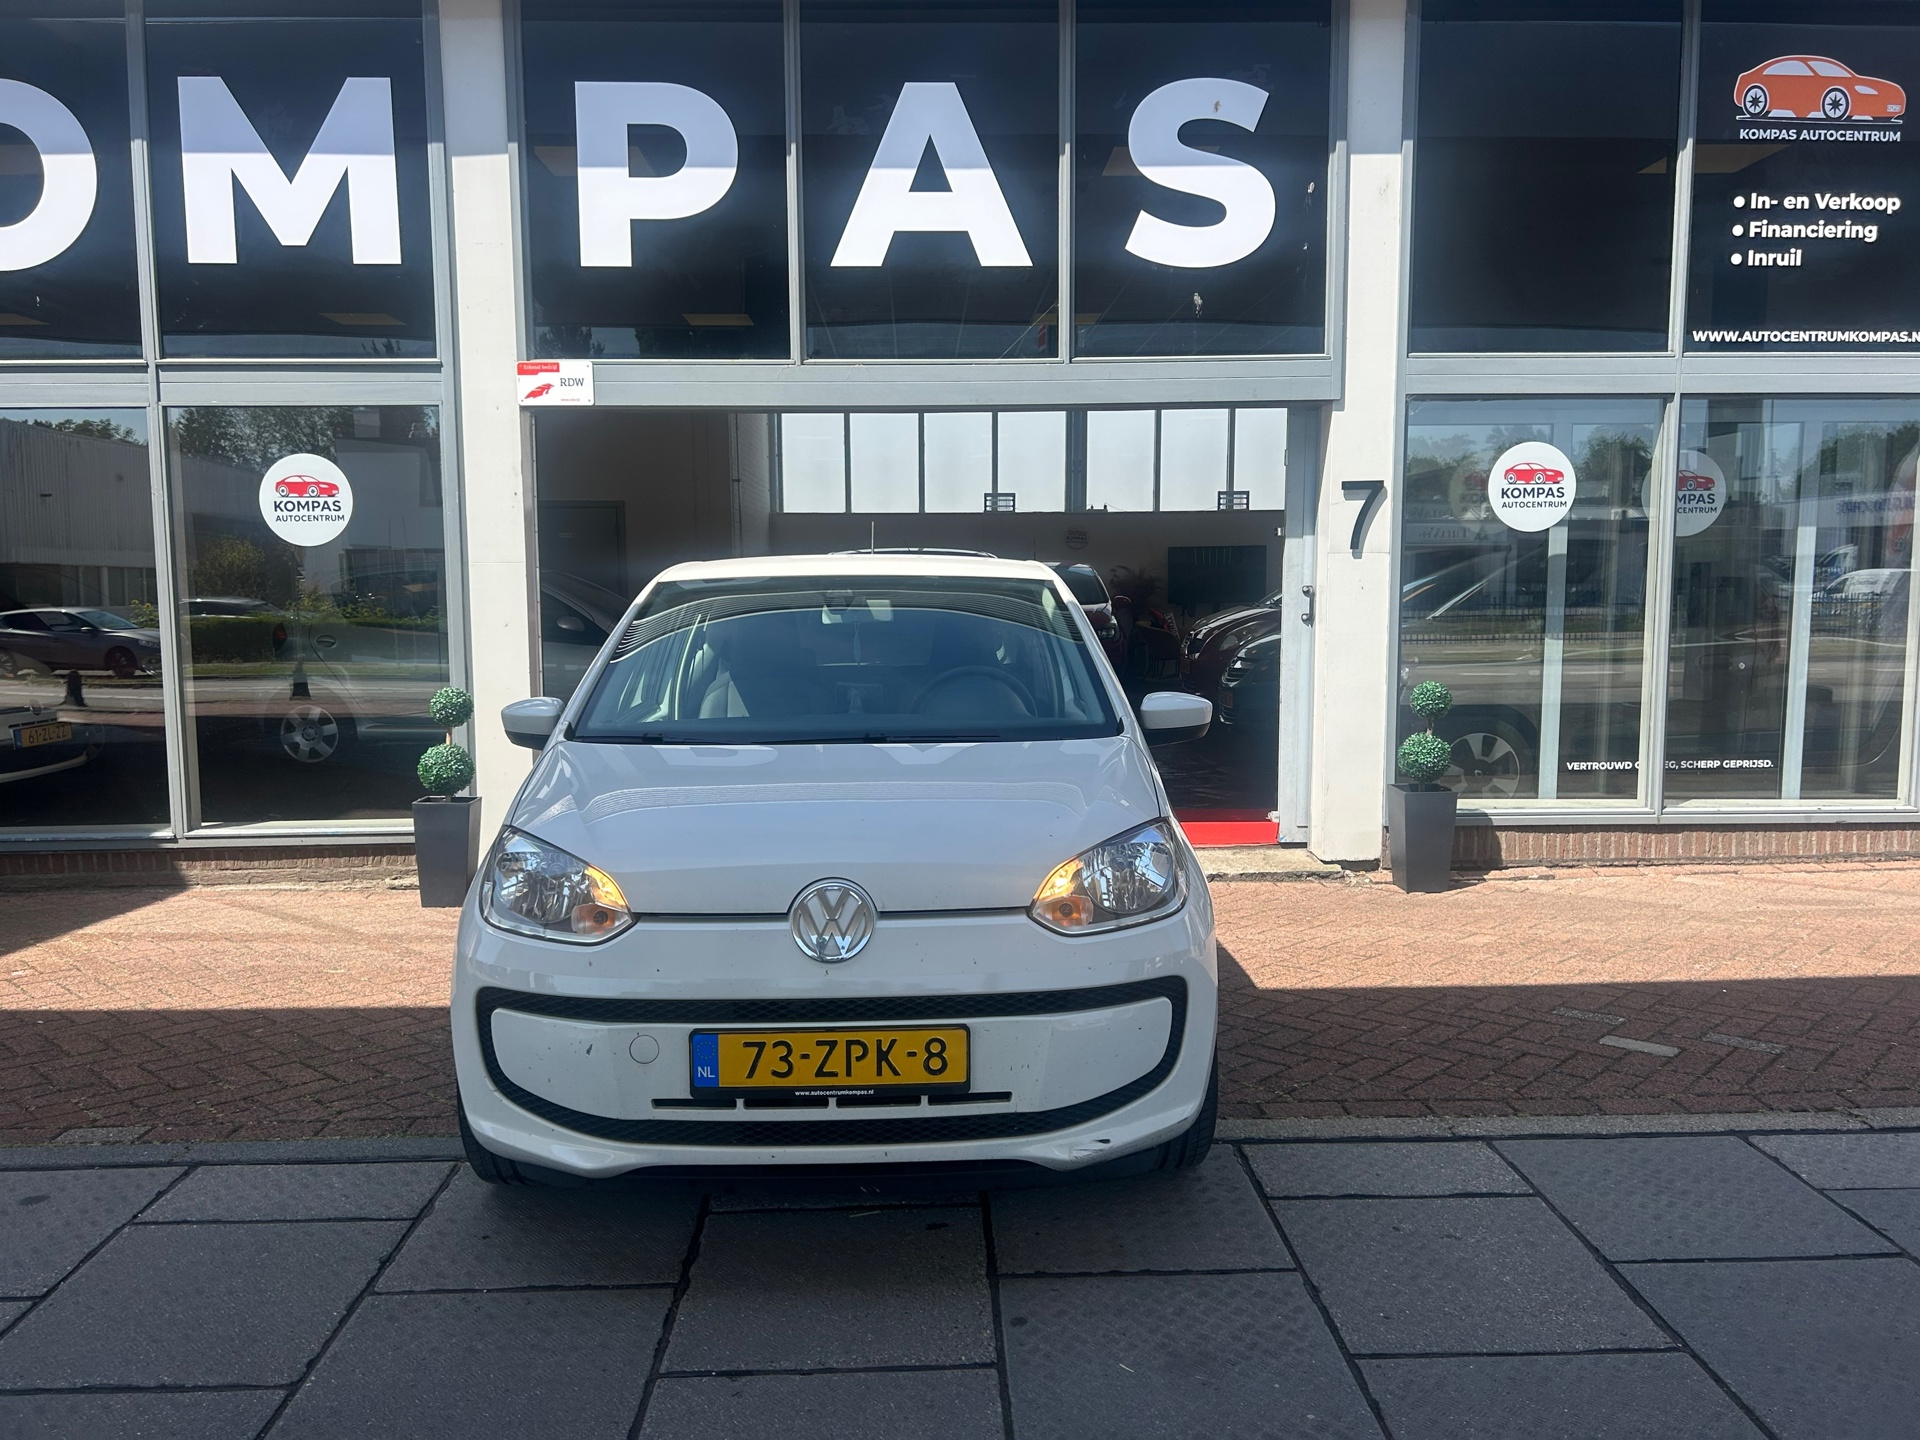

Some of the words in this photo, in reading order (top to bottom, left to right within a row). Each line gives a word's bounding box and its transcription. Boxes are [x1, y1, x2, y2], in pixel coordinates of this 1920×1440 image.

[1739, 128, 1797, 140] KOMPAS
[1800, 129, 1901, 142] AUTOCENTRUM
[1750, 192, 1779, 209] In-
[1783, 195, 1810, 209] en
[1814, 192, 1901, 214] Verkoop
[1749, 219, 1878, 242] Financiering
[1747, 248, 1802, 266] Inruil
[559, 377, 585, 387] RDW
[1501, 487, 1565, 499] KOMPAS
[1677, 493, 1716, 505] MPAS
[273, 500, 342, 513] KOMPAS
[1501, 500, 1568, 509] AUTOCENTRUM
[1677, 506, 1718, 514] CENTRUM
[275, 514, 345, 523] AUTOCENTRUM
[1342, 480, 1385, 550] 7
[1566, 761, 1633, 771] VERTROUWD
[1680, 760, 1721, 769] SCHERP
[1722, 759, 1774, 769] GEPRIJSD.
[697, 1066, 716, 1078] NL
[742, 1037, 949, 1079] 73-ZPK-8
[794, 1089, 875, 1097] www.autocentrumkompas.nl
